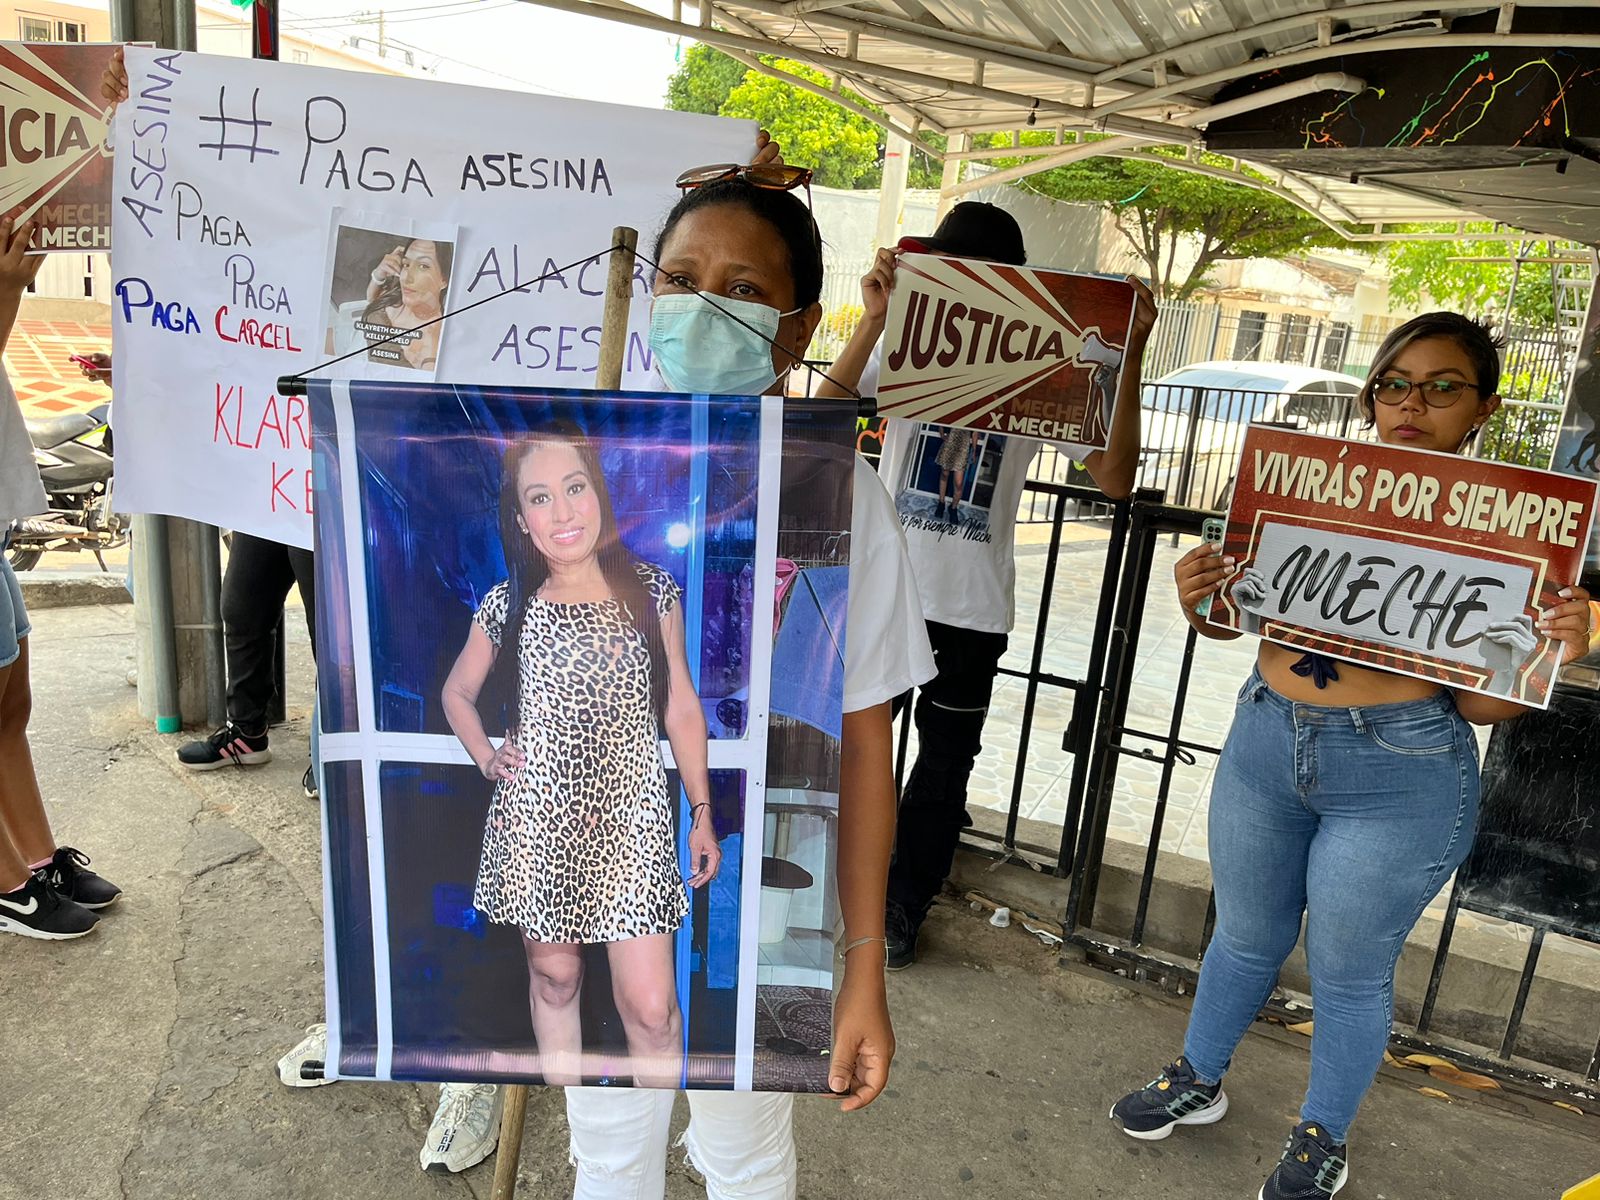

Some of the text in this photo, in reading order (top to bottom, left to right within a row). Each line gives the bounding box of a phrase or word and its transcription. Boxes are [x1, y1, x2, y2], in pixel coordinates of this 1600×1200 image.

[121, 51, 182, 238] ASESINA
[460, 152, 613, 196] ASESINA
[171, 181, 252, 247] PAGA
[115, 277, 302, 353] PAGA CARCEL
[224, 253, 292, 315] PAGA
[372, 350, 399, 359] ASESINA
[887, 290, 1065, 372] JUSTICIA
[214, 382, 312, 449] KLAR
[986, 411, 1082, 441] X MECHE
[1254, 444, 1584, 548] VIVIRÁS POR SIEMPRE
[1271, 544, 1506, 651] MECHE
